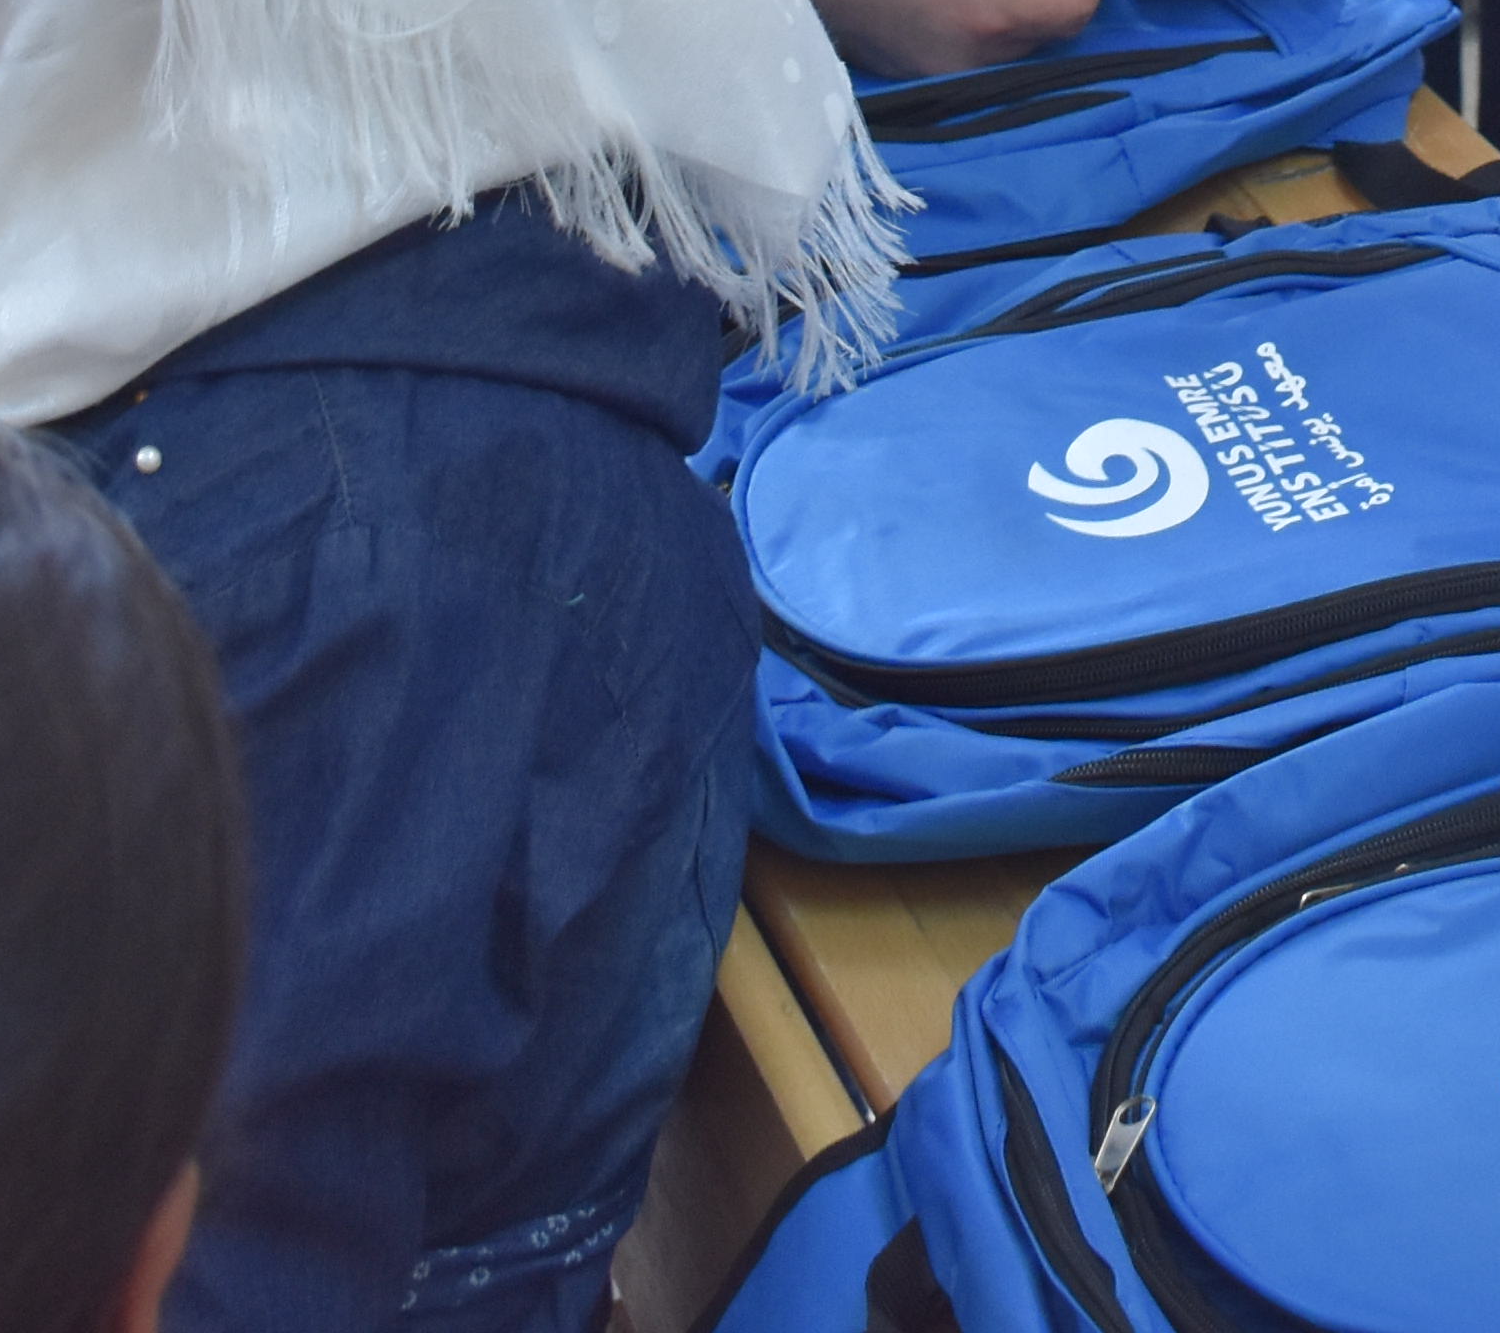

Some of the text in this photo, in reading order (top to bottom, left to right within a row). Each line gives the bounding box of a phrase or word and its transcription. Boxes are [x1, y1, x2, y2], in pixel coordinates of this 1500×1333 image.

[1164, 374, 1302, 532] YUNUS EMRE
[1203, 361, 1349, 522] ENSTİTÜSÜ
[1256, 342, 1309, 411] معهد
[1302, 412, 1365, 468] يونس
